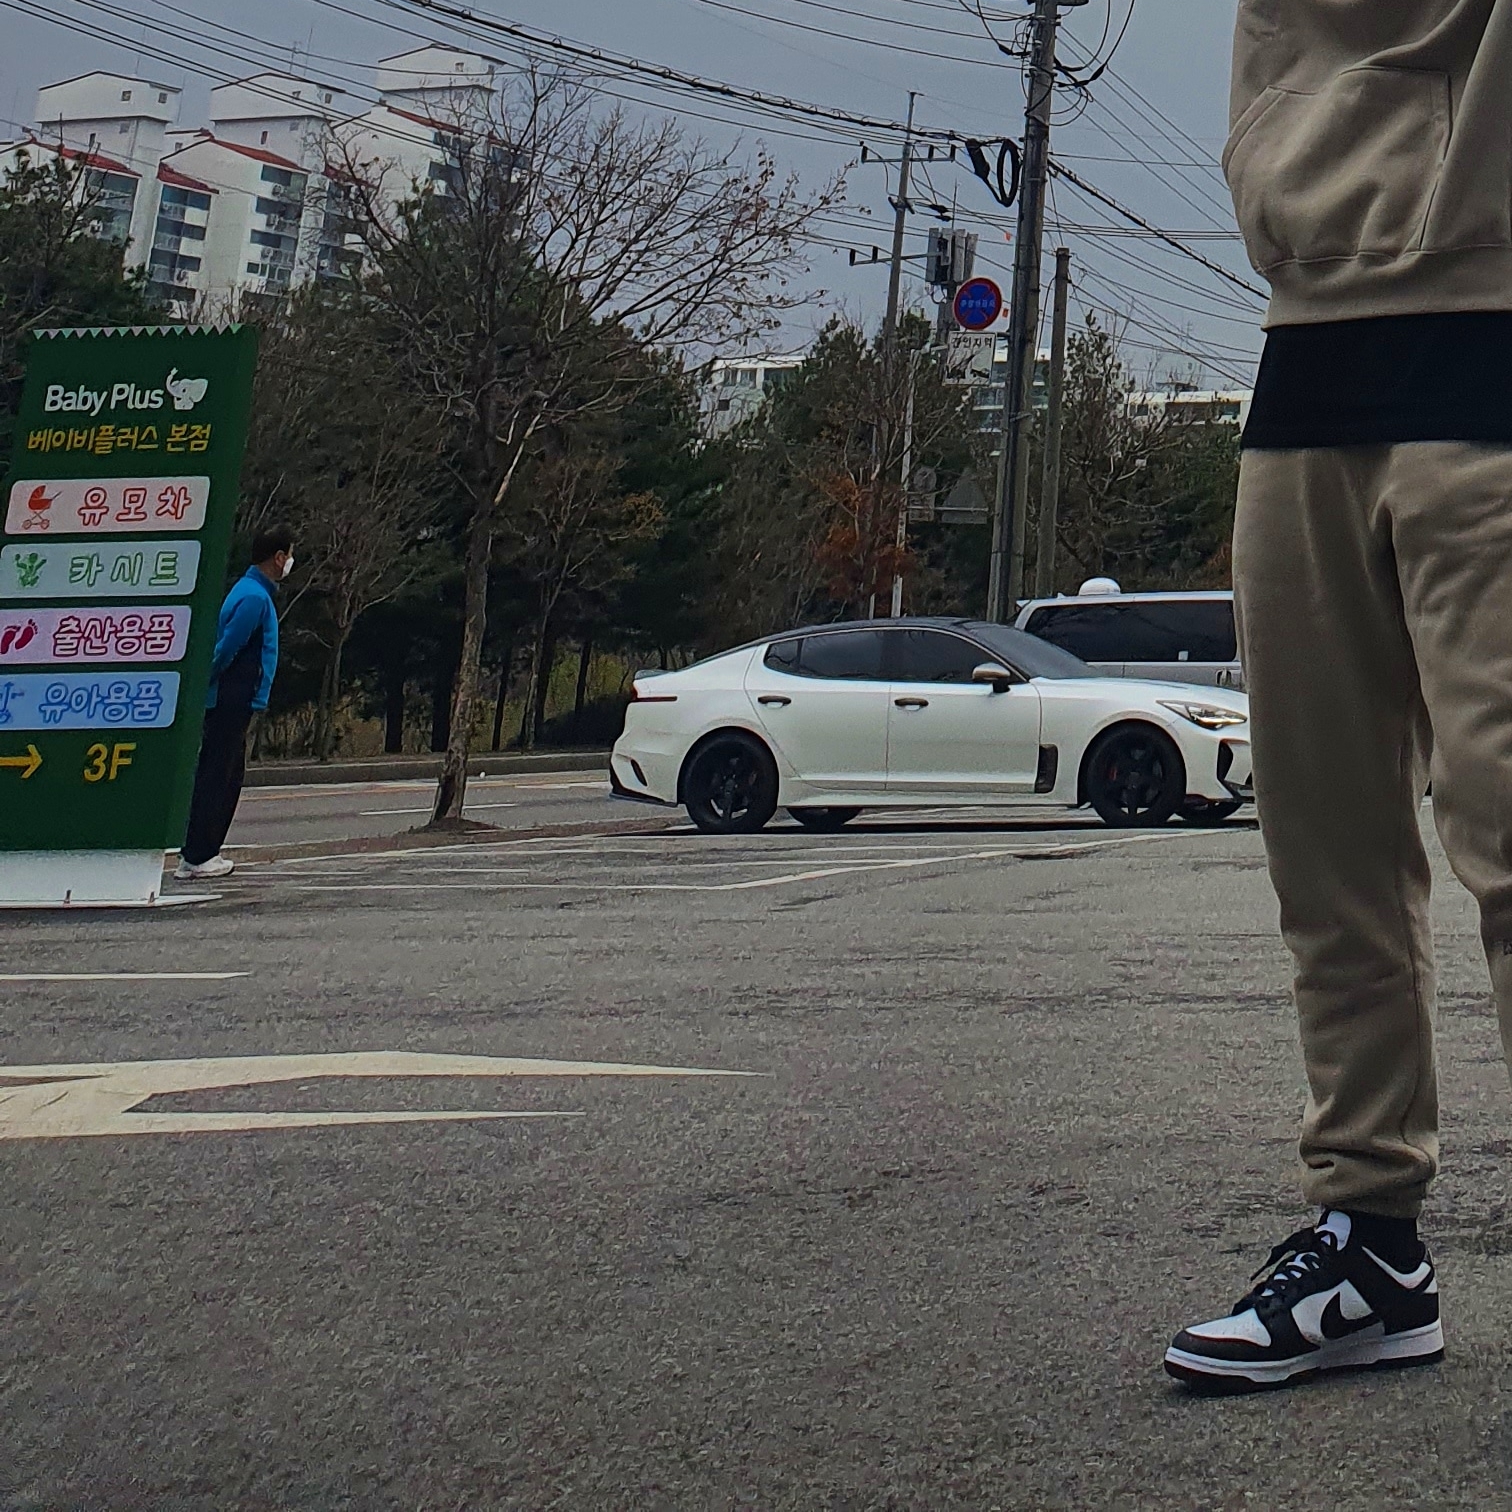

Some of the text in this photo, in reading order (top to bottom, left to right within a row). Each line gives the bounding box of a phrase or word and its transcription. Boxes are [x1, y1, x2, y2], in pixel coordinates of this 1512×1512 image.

[44, 383, 165, 416] Baby Plus
[27, 423, 212, 455] 베이비플러스 본점
[77, 485, 193, 527] 유모차
[68, 550, 181, 588] 카시트
[52, 613, 176, 658] 출산용품
[38, 679, 164, 724] 유아용품
[82, 742, 138, 782] 3F
